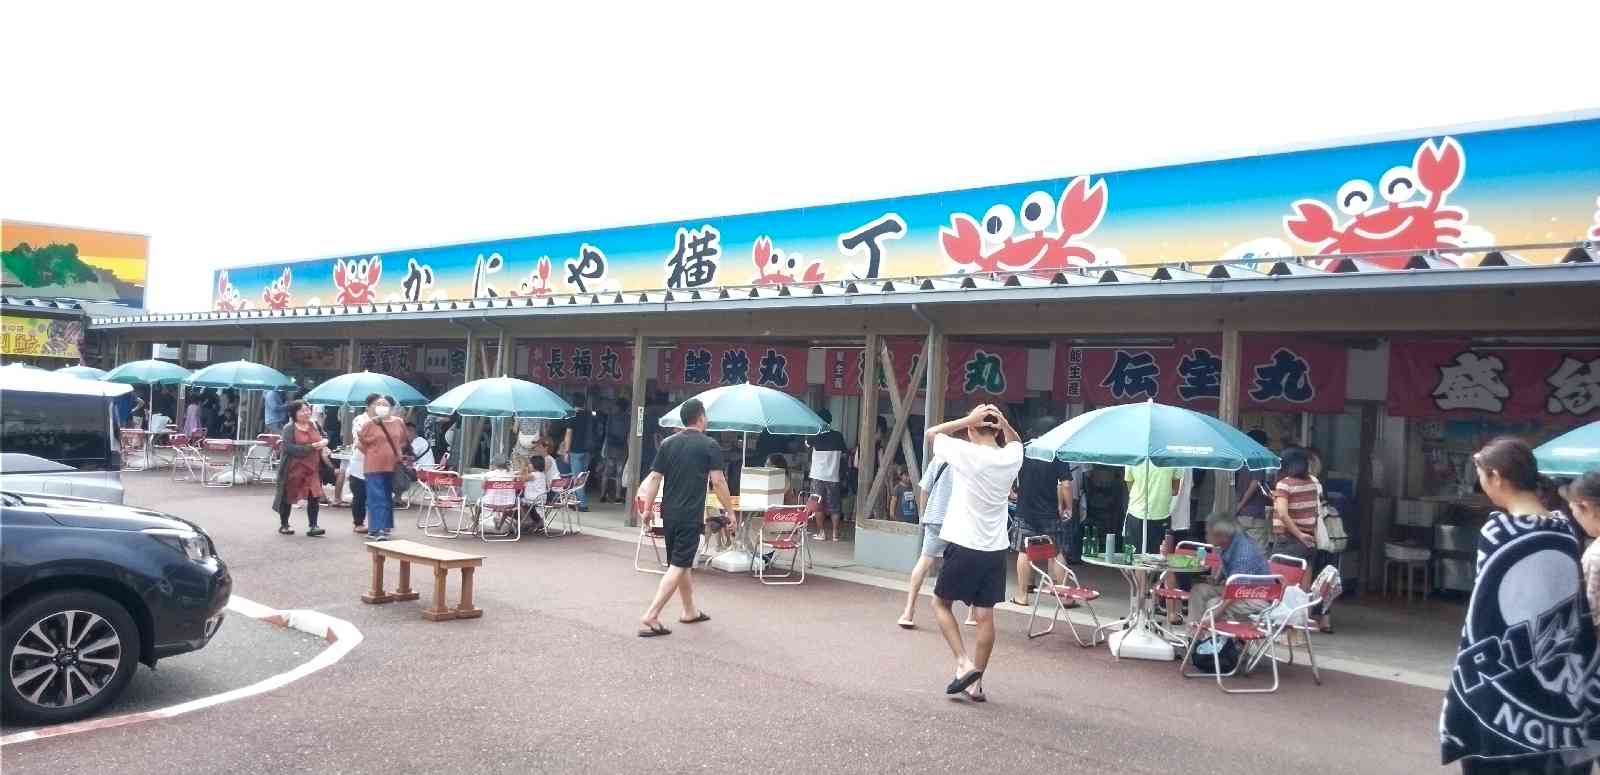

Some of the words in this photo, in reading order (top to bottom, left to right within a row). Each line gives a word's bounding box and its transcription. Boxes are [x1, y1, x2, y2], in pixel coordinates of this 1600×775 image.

[402, 215, 904, 303] かにや横丁
[545, 344, 624, 382] 長福丸
[1101, 348, 1315, 403] 伝宝丸
[1234, 586, 1270, 599] Coca-Cola
